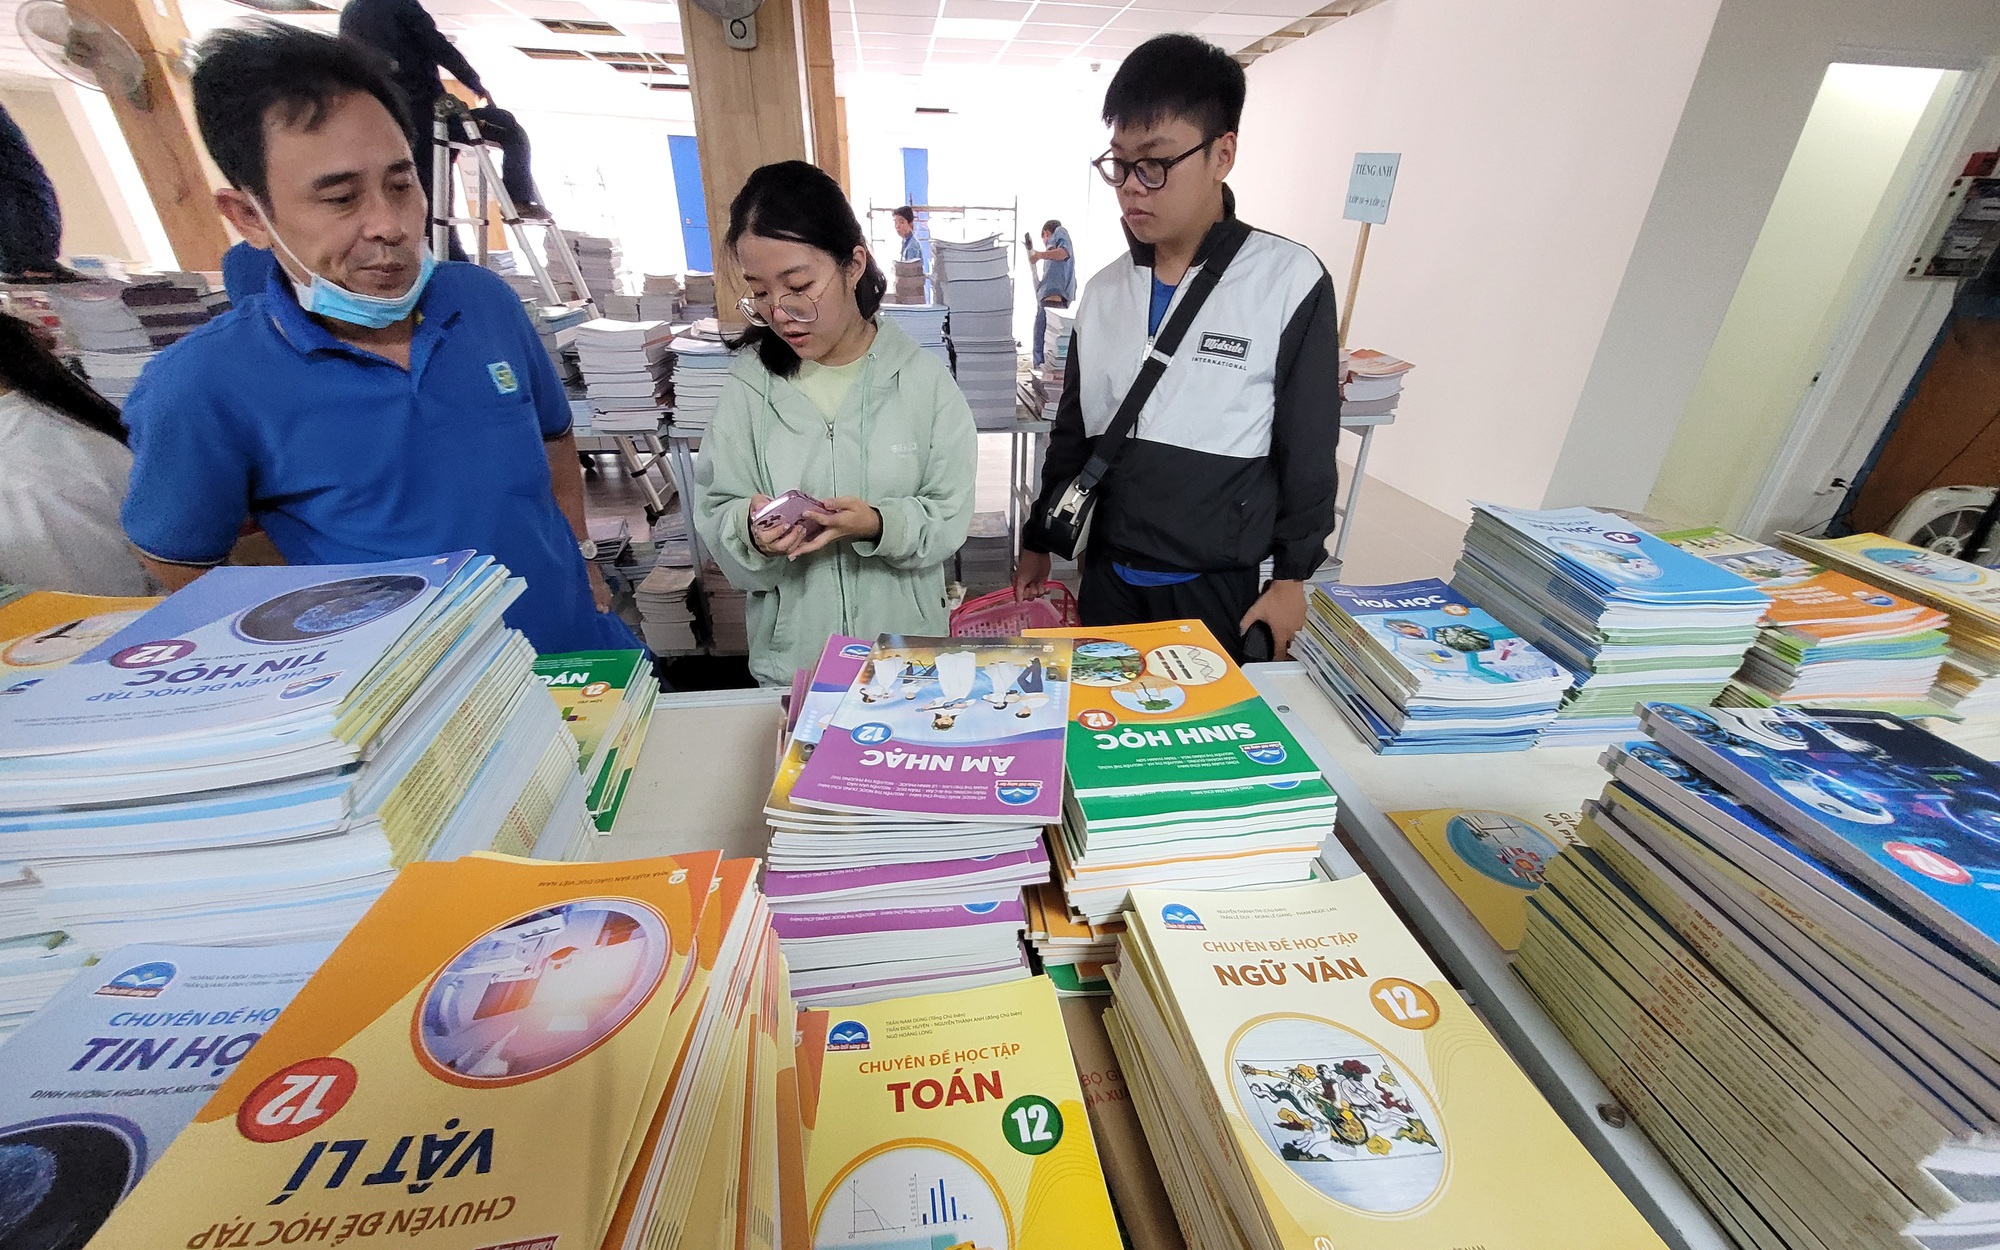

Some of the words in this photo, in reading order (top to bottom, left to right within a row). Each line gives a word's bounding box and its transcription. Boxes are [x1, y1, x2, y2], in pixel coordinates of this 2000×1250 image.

[1356, 162, 1377, 176] TIẾNG
[1378, 166, 1393, 177] ANH
[1192, 357, 1248, 371] INTERNATIONAL
[1352, 598, 1396, 609] HOÁ
[1396, 595, 1447, 608] HỌC
[124, 645, 184, 664] 12
[251, 650, 330, 676] TIN
[124, 662, 249, 687] HỌC
[231, 666, 318, 689] CHUYÊN
[85, 688, 133, 702] TẬP
[136, 686, 188, 699] HỌC
[197, 681, 229, 695] ĐỀ
[586, 684, 606, 696] 12
[1084, 713, 1114, 728] 12
[858, 727, 885, 742] 12
[1093, 728, 1172, 750] HỌC
[1174, 723, 1257, 745] SINH
[859, 748, 955, 772] NHẠC
[961, 756, 1015, 777] ÂM
[1202, 938, 1268, 953] CHUYÊN
[1269, 936, 1293, 952] ĐỀ
[1295, 936, 1331, 951] HỌC
[1329, 932, 1359, 948] TẬP
[1213, 958, 1288, 987] NGỮ
[1292, 956, 1369, 985] VĂN
[1376, 986, 1430, 1021] 12
[109, 1009, 211, 1028] CHUYÊN
[207, 1005, 244, 1026] ĐỀ
[928, 1015, 943, 1023] (Tổng
[67, 1037, 179, 1072] TIN
[859, 1055, 925, 1074] CHUYÊN
[929, 1049, 951, 1066] ĐỀ
[955, 1047, 989, 1065] HỌC
[990, 1043, 1021, 1060] TẬP
[30, 1089, 66, 1100] ĐỊNH
[64, 1087, 112, 1100] HƯỚNG
[110, 1088, 146, 1099] KHOA
[146, 1087, 175, 1097] HỌC
[174, 1084, 203, 1094] MÁY
[256, 1074, 339, 1126] 12
[887, 1068, 1004, 1113] TOÁN
[1011, 1104, 1052, 1144] 12
[362, 1118, 495, 1194] VẬT
[266, 1139, 368, 1206] LÍ
[388, 1195, 517, 1237] CHUYÊN
[186, 1215, 257, 1250] TẬP
[255, 1211, 337, 1247] HỌC
[331, 1210, 387, 1248] ĐỀ
